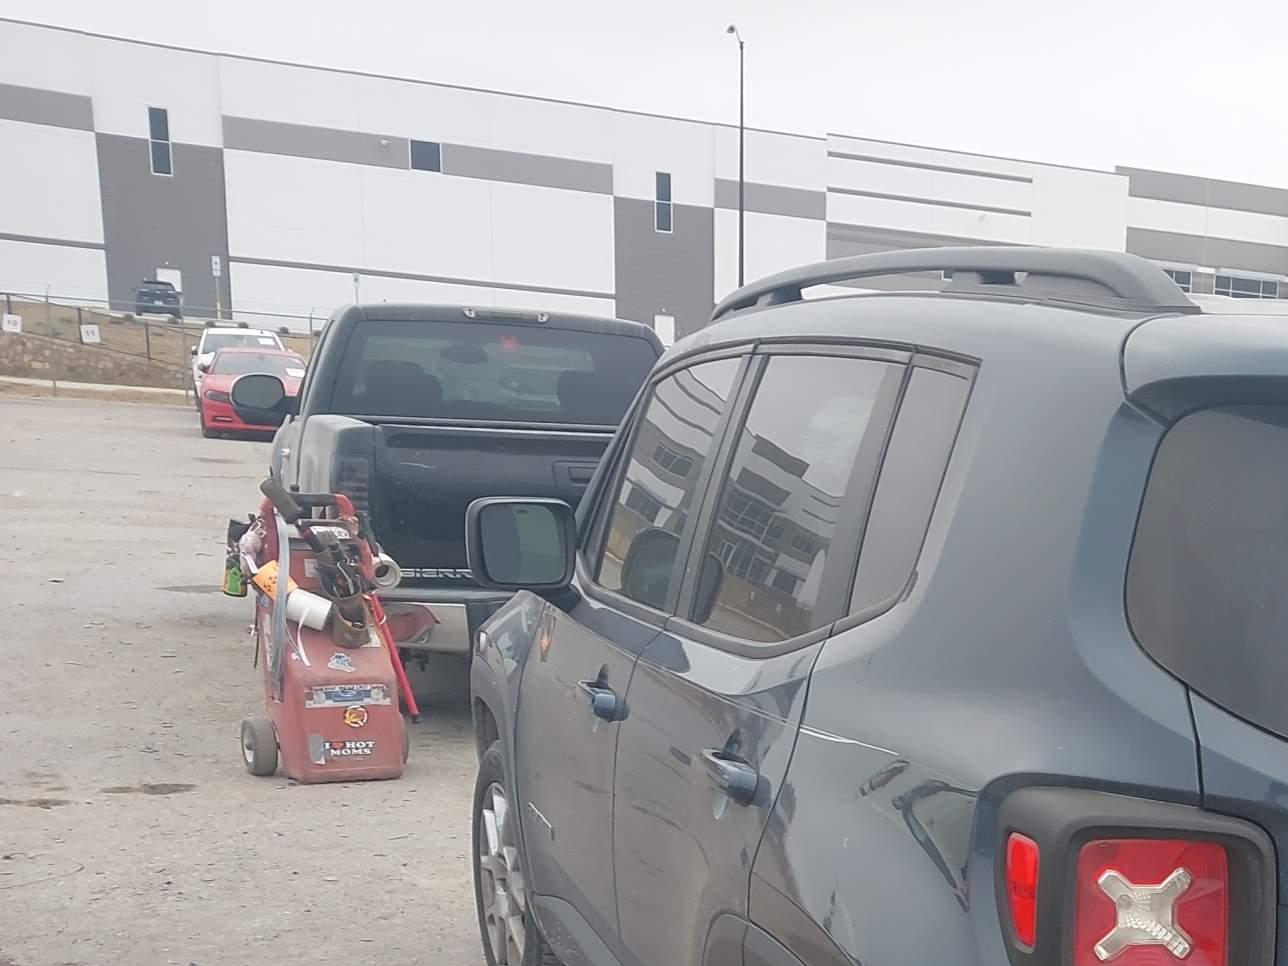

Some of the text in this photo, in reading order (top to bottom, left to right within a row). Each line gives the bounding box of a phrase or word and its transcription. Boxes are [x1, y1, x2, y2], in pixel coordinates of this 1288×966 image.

[399, 567, 473, 578] SIERR
[345, 741, 375, 749] HOT
[330, 748, 372, 756] MOMS
